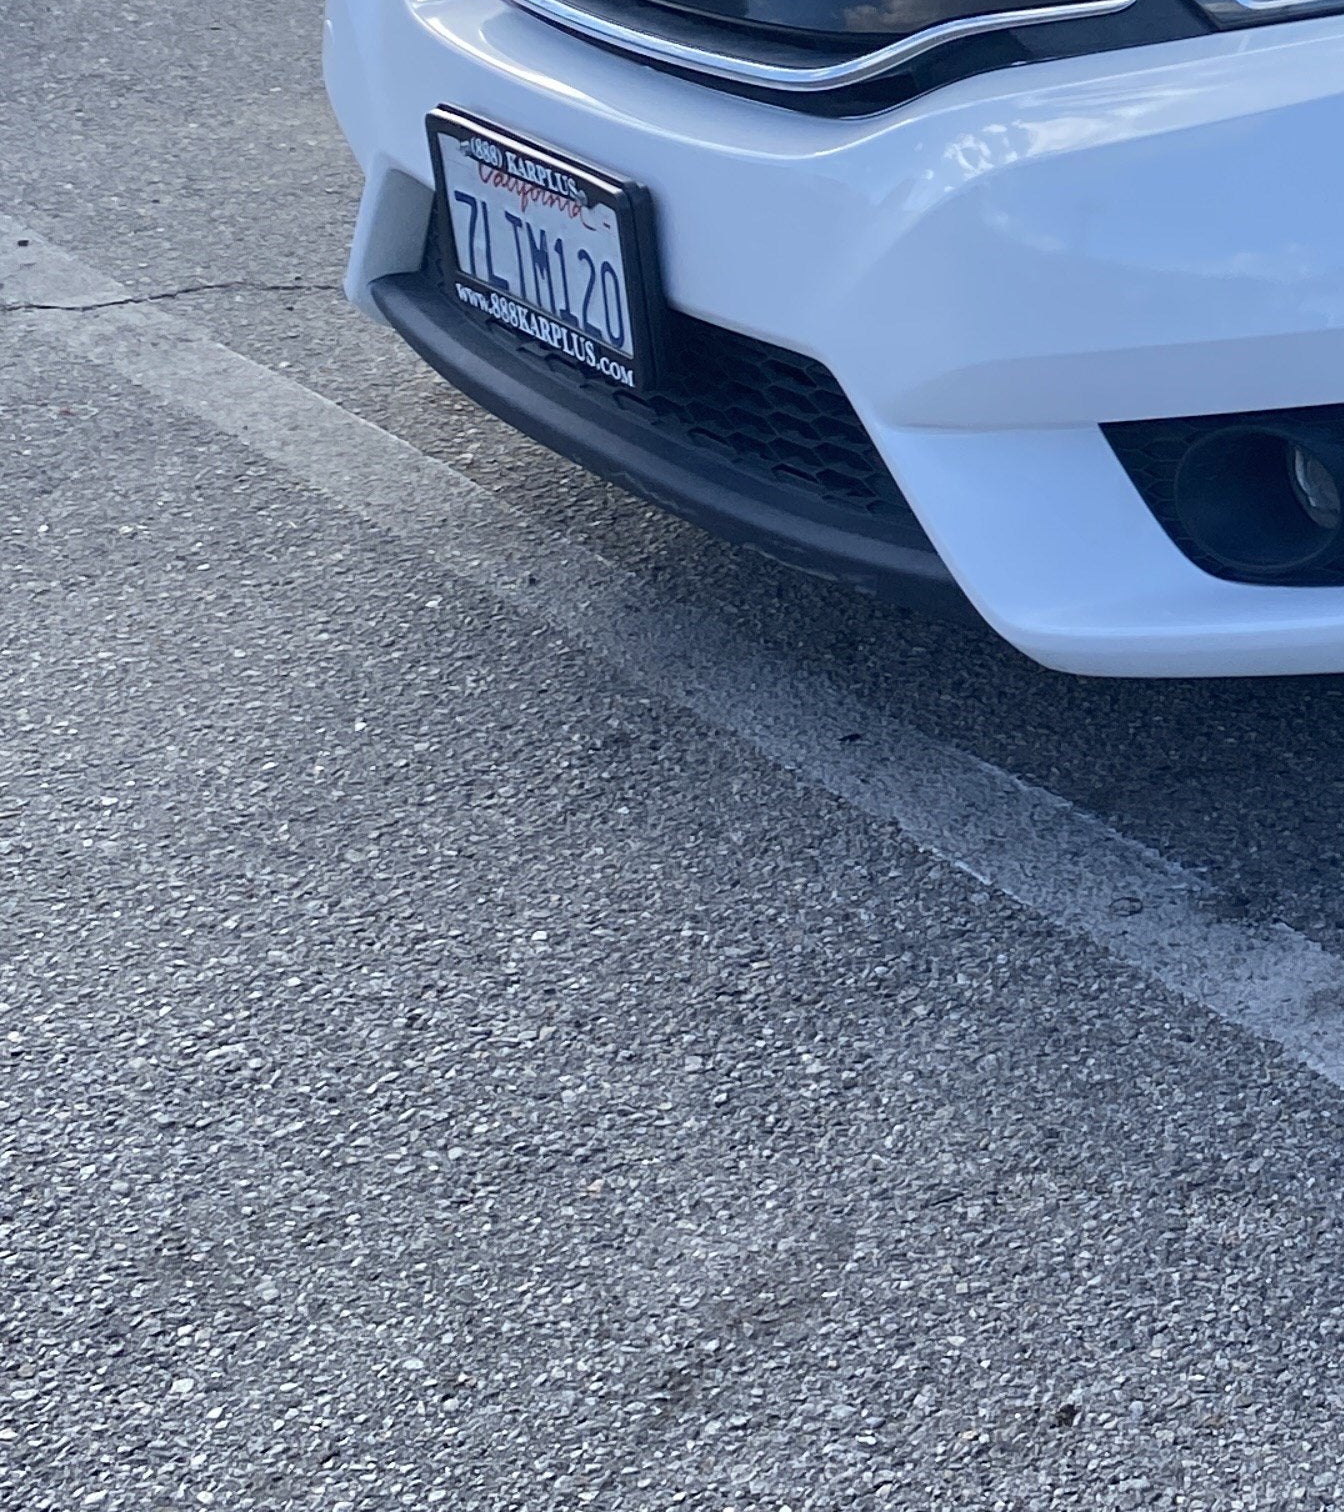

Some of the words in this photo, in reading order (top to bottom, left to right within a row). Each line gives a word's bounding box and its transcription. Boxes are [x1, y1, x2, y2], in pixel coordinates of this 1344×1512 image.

[470, 137, 503, 168] (888)
[506, 150, 579, 199] KARPLUS
[454, 190, 624, 349] 7LTM120
